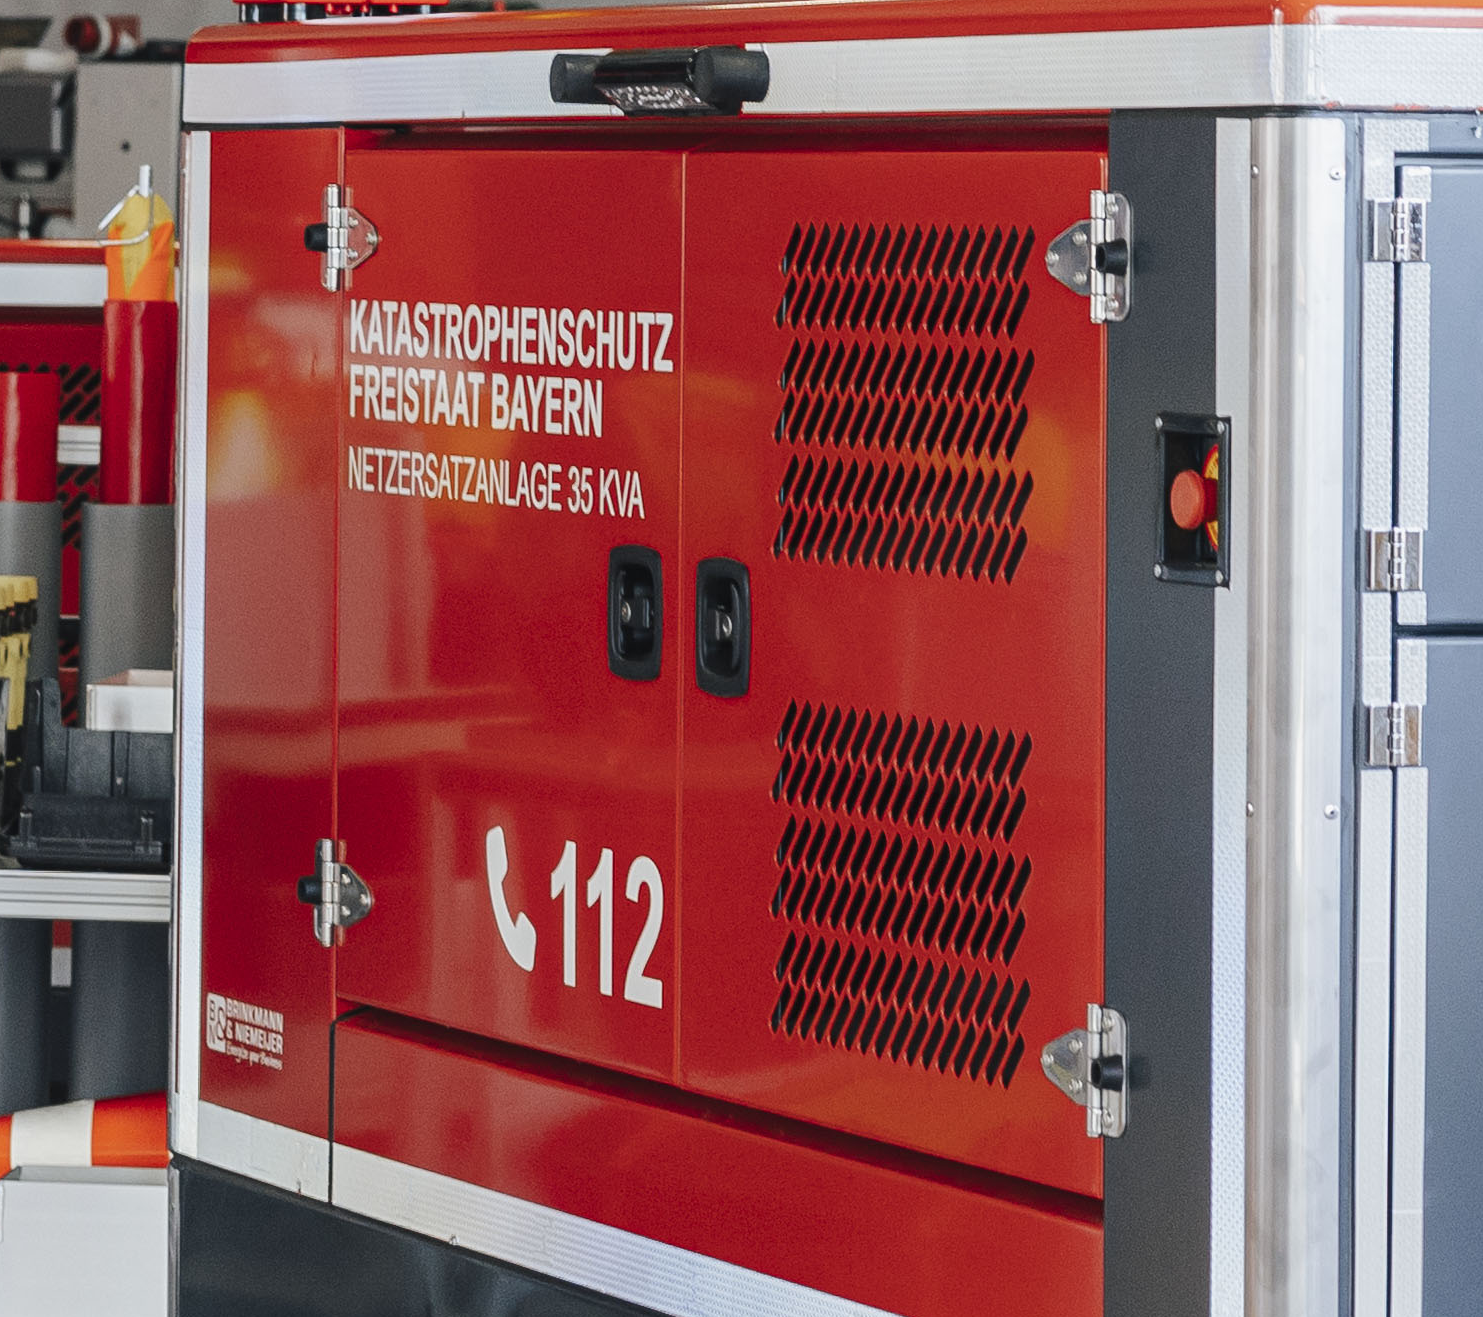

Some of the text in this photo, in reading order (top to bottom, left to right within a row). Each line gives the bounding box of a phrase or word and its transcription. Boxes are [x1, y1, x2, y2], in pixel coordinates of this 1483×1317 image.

[349, 298, 674, 372] KATASTROPHENSCHUTZ
[349, 364, 603, 438] FREISTAAT BAYERN
[348, 445, 646, 520] NETZERSATZANLAGE 35 KVA
[551, 840, 663, 1009] 112
[226, 997, 284, 1033] BRINKMANN
[235, 1022, 284, 1056] NIEMEIJER
